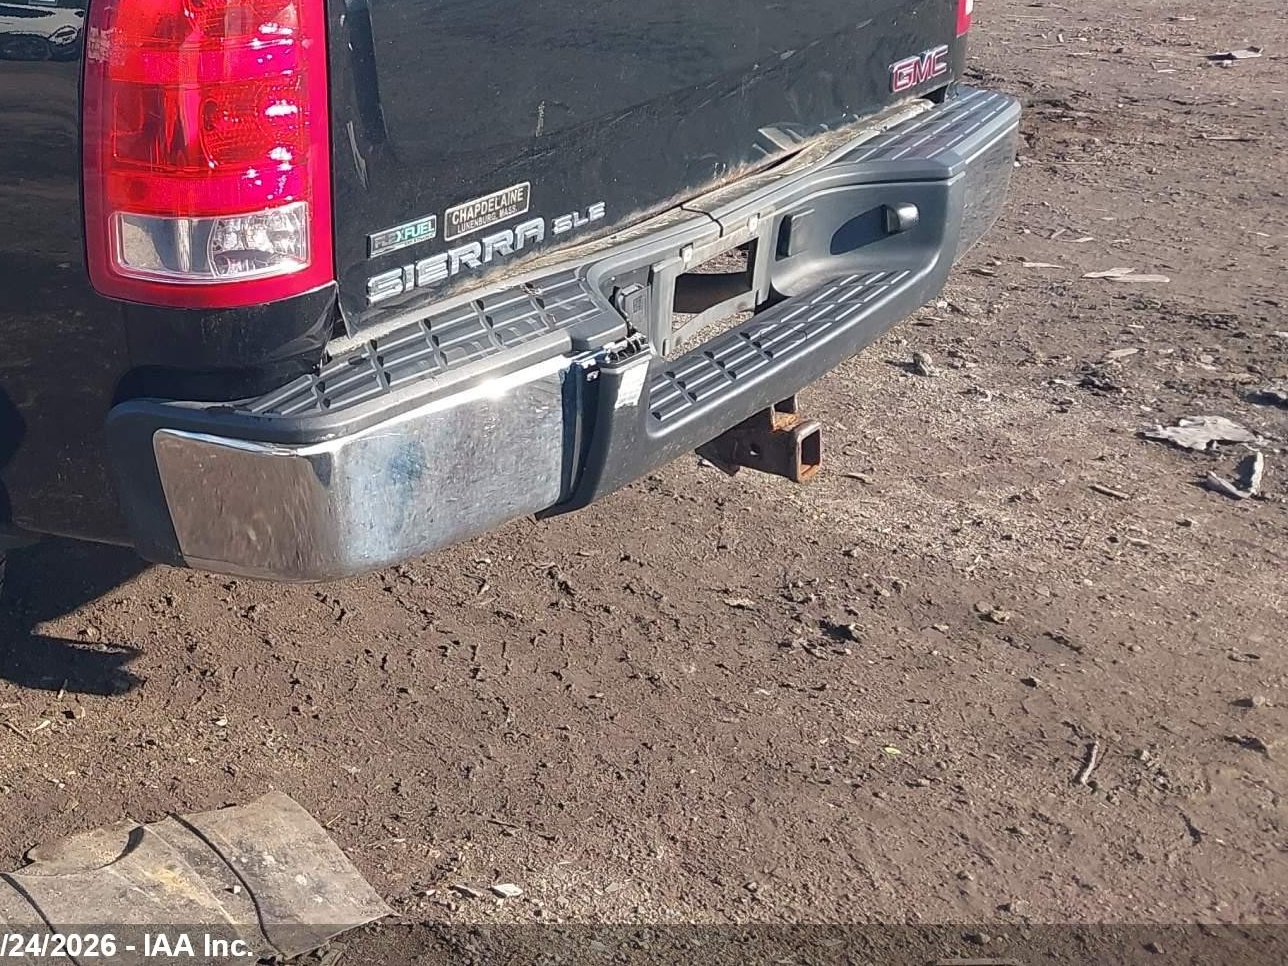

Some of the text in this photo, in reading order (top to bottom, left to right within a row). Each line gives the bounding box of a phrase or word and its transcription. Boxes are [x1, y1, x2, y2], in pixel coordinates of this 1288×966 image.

[890, 45, 949, 92] GMC
[452, 187, 524, 225] CHAPDELAINE
[367, 201, 605, 305] SIERRA SLE
